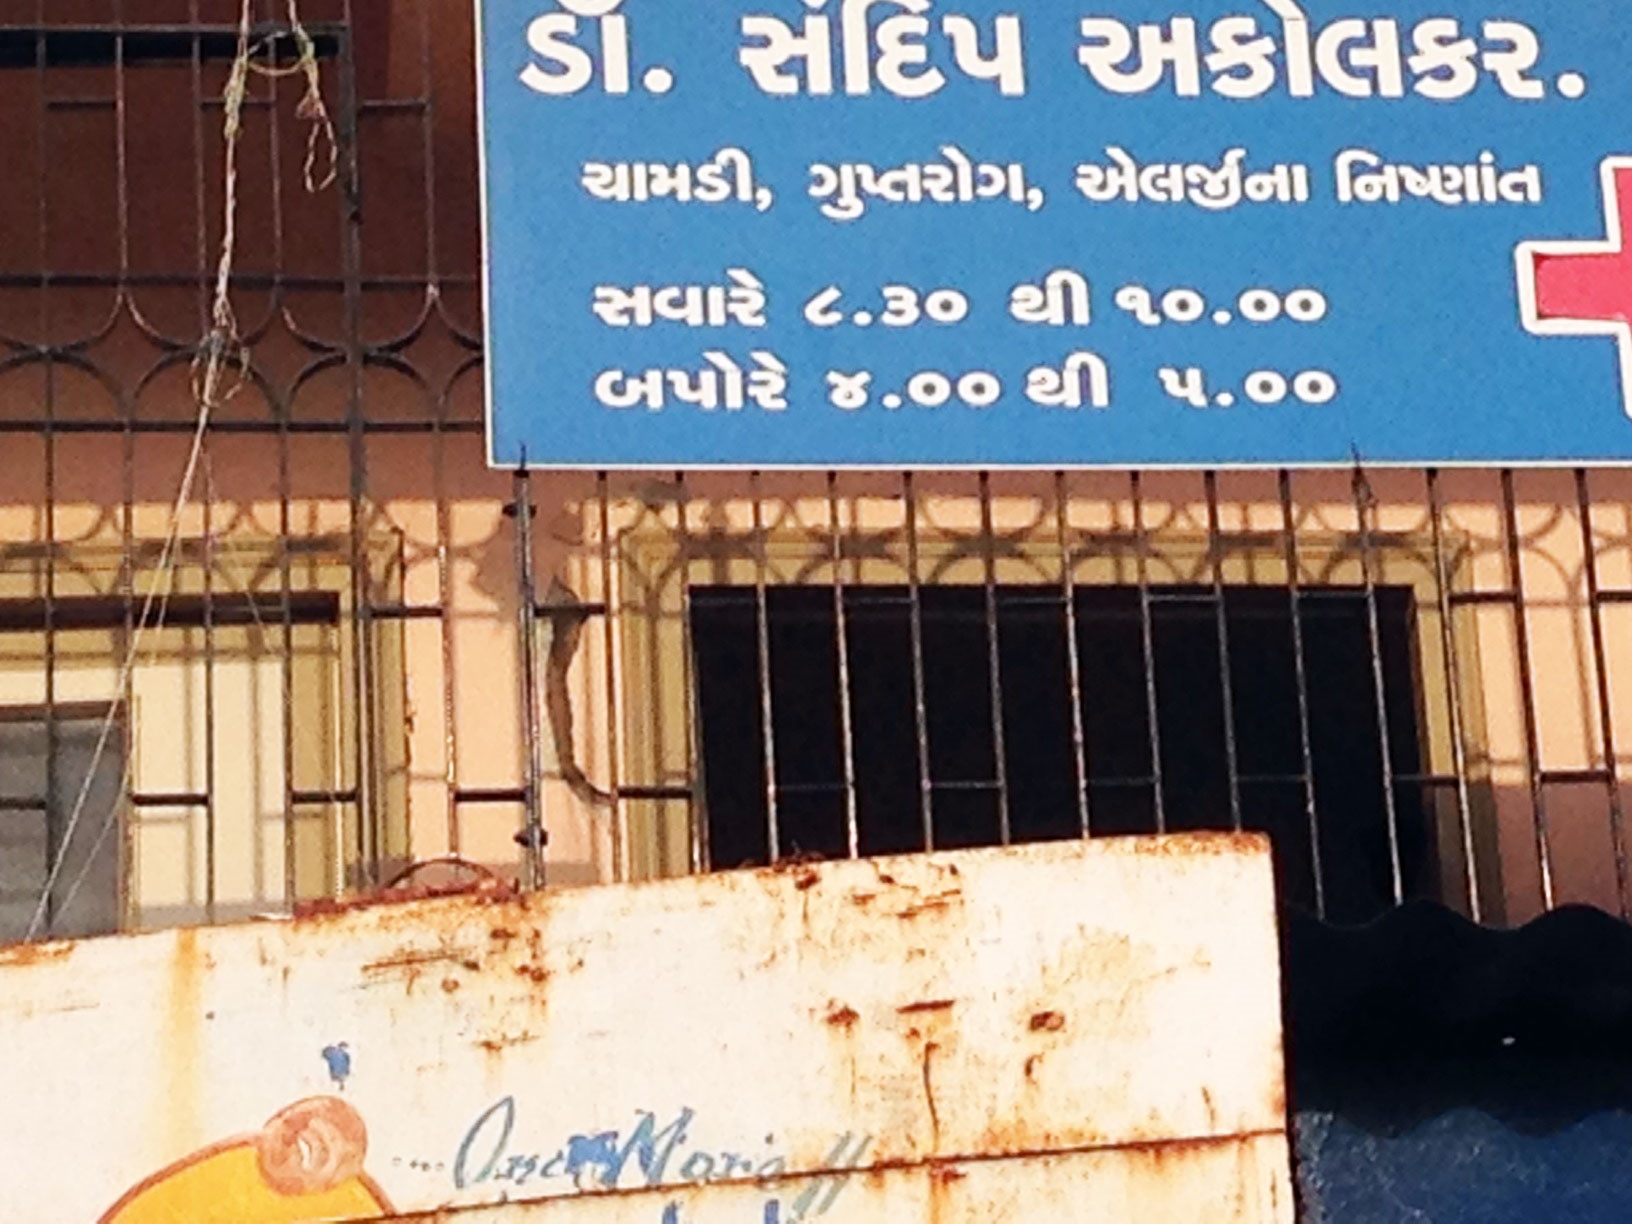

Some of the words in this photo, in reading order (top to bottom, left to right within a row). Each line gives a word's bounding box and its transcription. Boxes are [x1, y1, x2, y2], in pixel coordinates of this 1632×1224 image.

[582, 148, 772, 211] ચામડી,
[808, 146, 1043, 220] ગુપ્તરોગ,
[1076, 147, 1308, 209] એલર્જીના
[1336, 150, 1541, 204] નિષ્ણાંત
[593, 269, 765, 326] સવારે
[805, 286, 967, 326] ૮.૩૦
[1010, 270, 1089, 325] થી
[1116, 286, 1326, 325] ૧૦.૦૦
[595, 352, 787, 410] બપોરે
[827, 371, 1000, 409] ૪.૦૦
[1026, 352, 1108, 407] થી
[1159, 368, 1335, 407] ૫.૦૦
